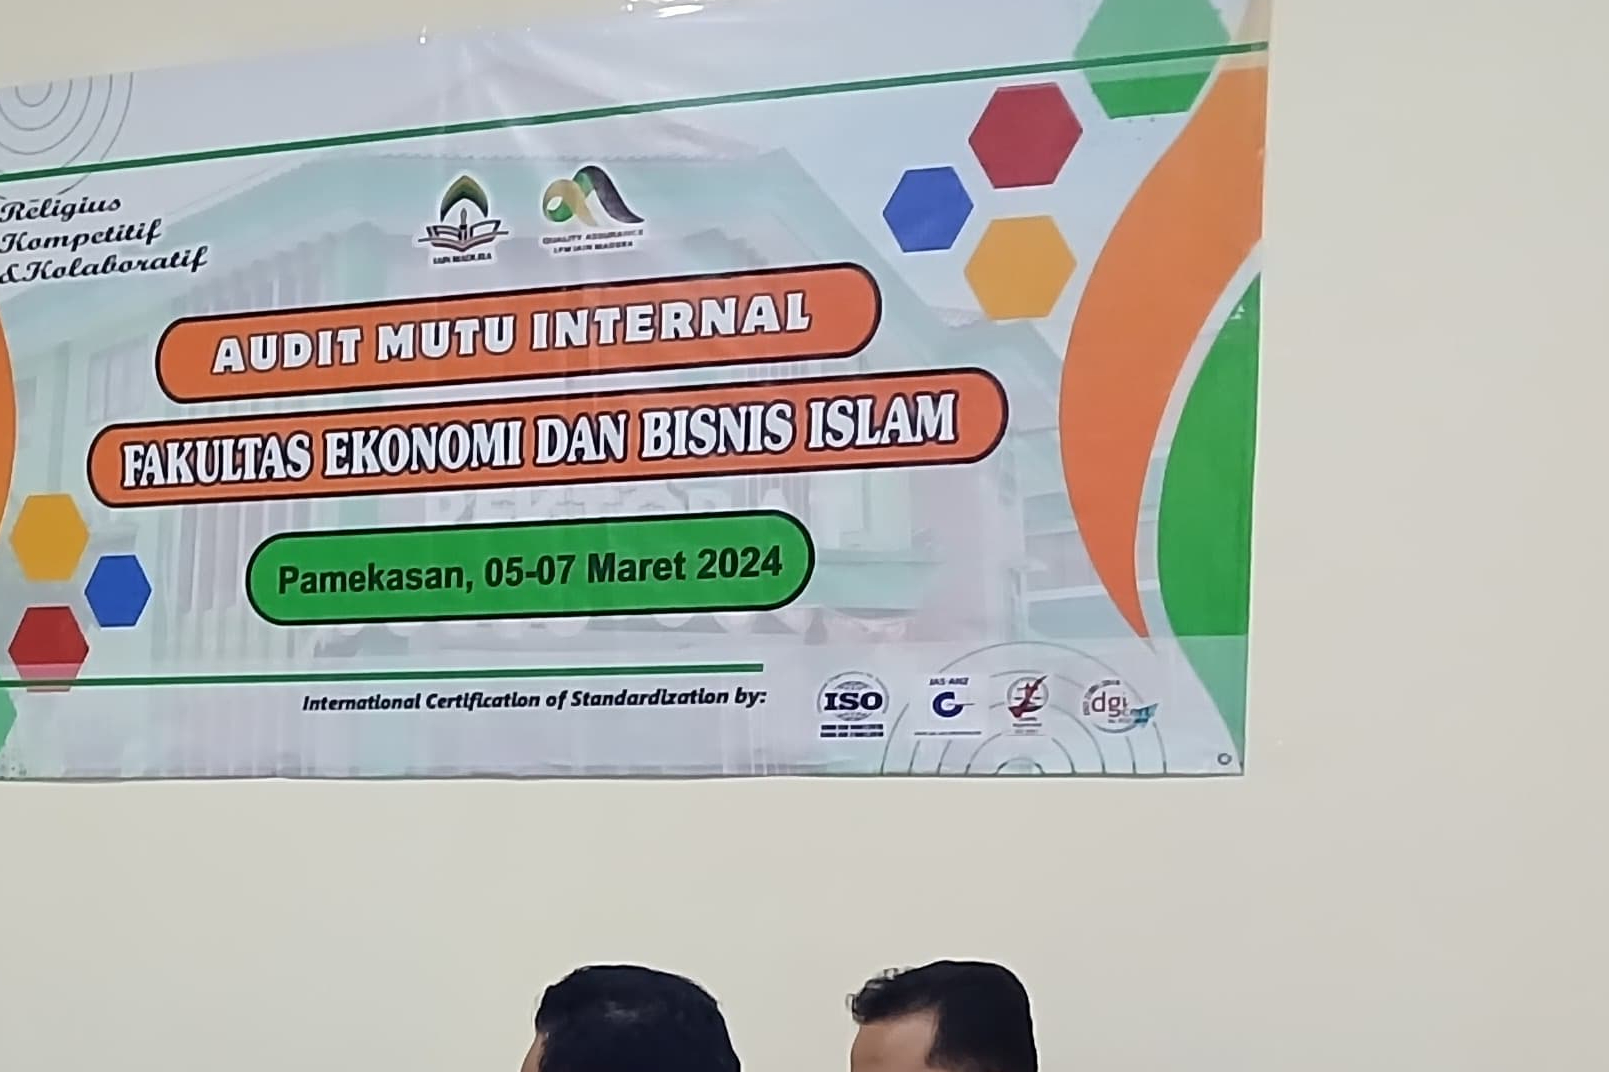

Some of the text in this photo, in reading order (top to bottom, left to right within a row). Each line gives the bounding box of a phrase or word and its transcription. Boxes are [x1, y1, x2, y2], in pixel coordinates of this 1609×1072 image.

[211, 291, 812, 374] AUDIT MUTU INTERNAL
[122, 393, 956, 487] FAKULTAS EKONOMI DAN BISNIS ISLAM
[278, 545, 783, 595] Pamekasan, 05-07 Maret 2024
[302, 686, 767, 712] International Certification of Standardization by:
[823, 691, 883, 711] ISO
